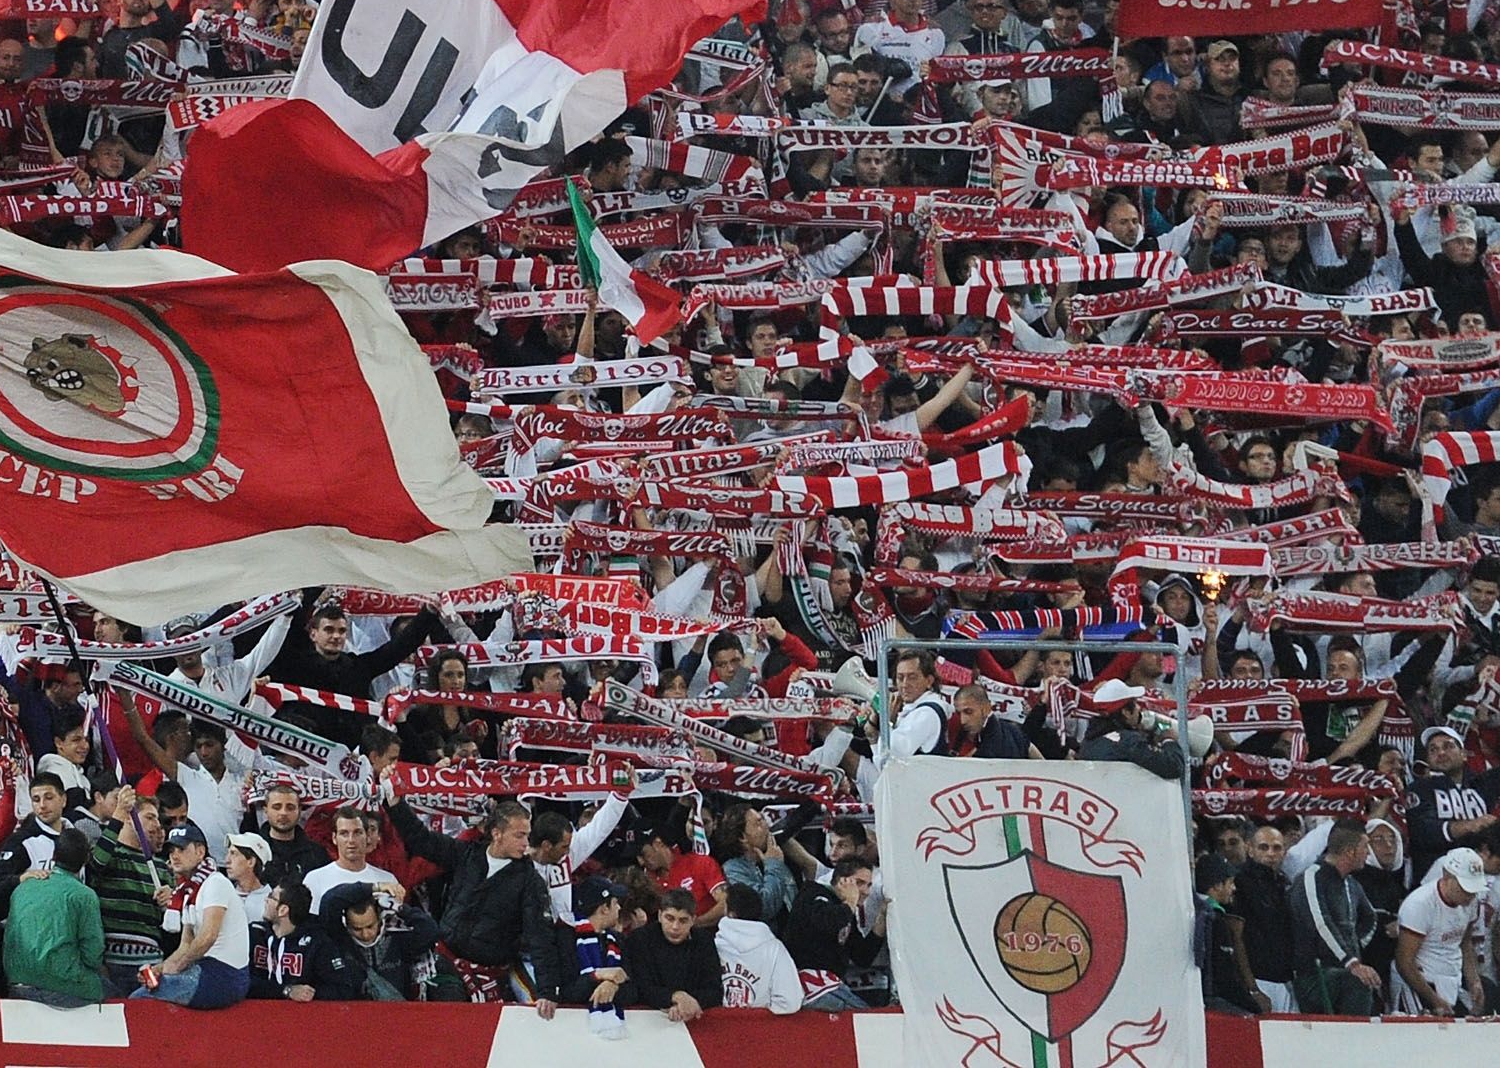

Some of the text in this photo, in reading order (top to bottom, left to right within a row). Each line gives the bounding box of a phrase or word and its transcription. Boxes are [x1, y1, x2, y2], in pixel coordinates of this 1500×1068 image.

[1337, 41, 1415, 66] U.C.N.
[46, 200, 109, 215] NORD
[1230, 313, 1289, 329] Bari
[480, 356, 688, 389] Bari 1991
[1195, 380, 1274, 404] MAGICO
[520, 413, 566, 437] Noi
[532, 481, 575, 505] Noi
[1144, 544, 1221, 564] as bari
[787, 684, 812, 697] 2004
[112, 662, 329, 758] Stampo Italiano
[409, 766, 607, 788] U.C.N. BARI
[947, 785, 1102, 826] ULTRAS
[1434, 789, 1488, 819] BARI
[1003, 930, 1083, 956] 1976
